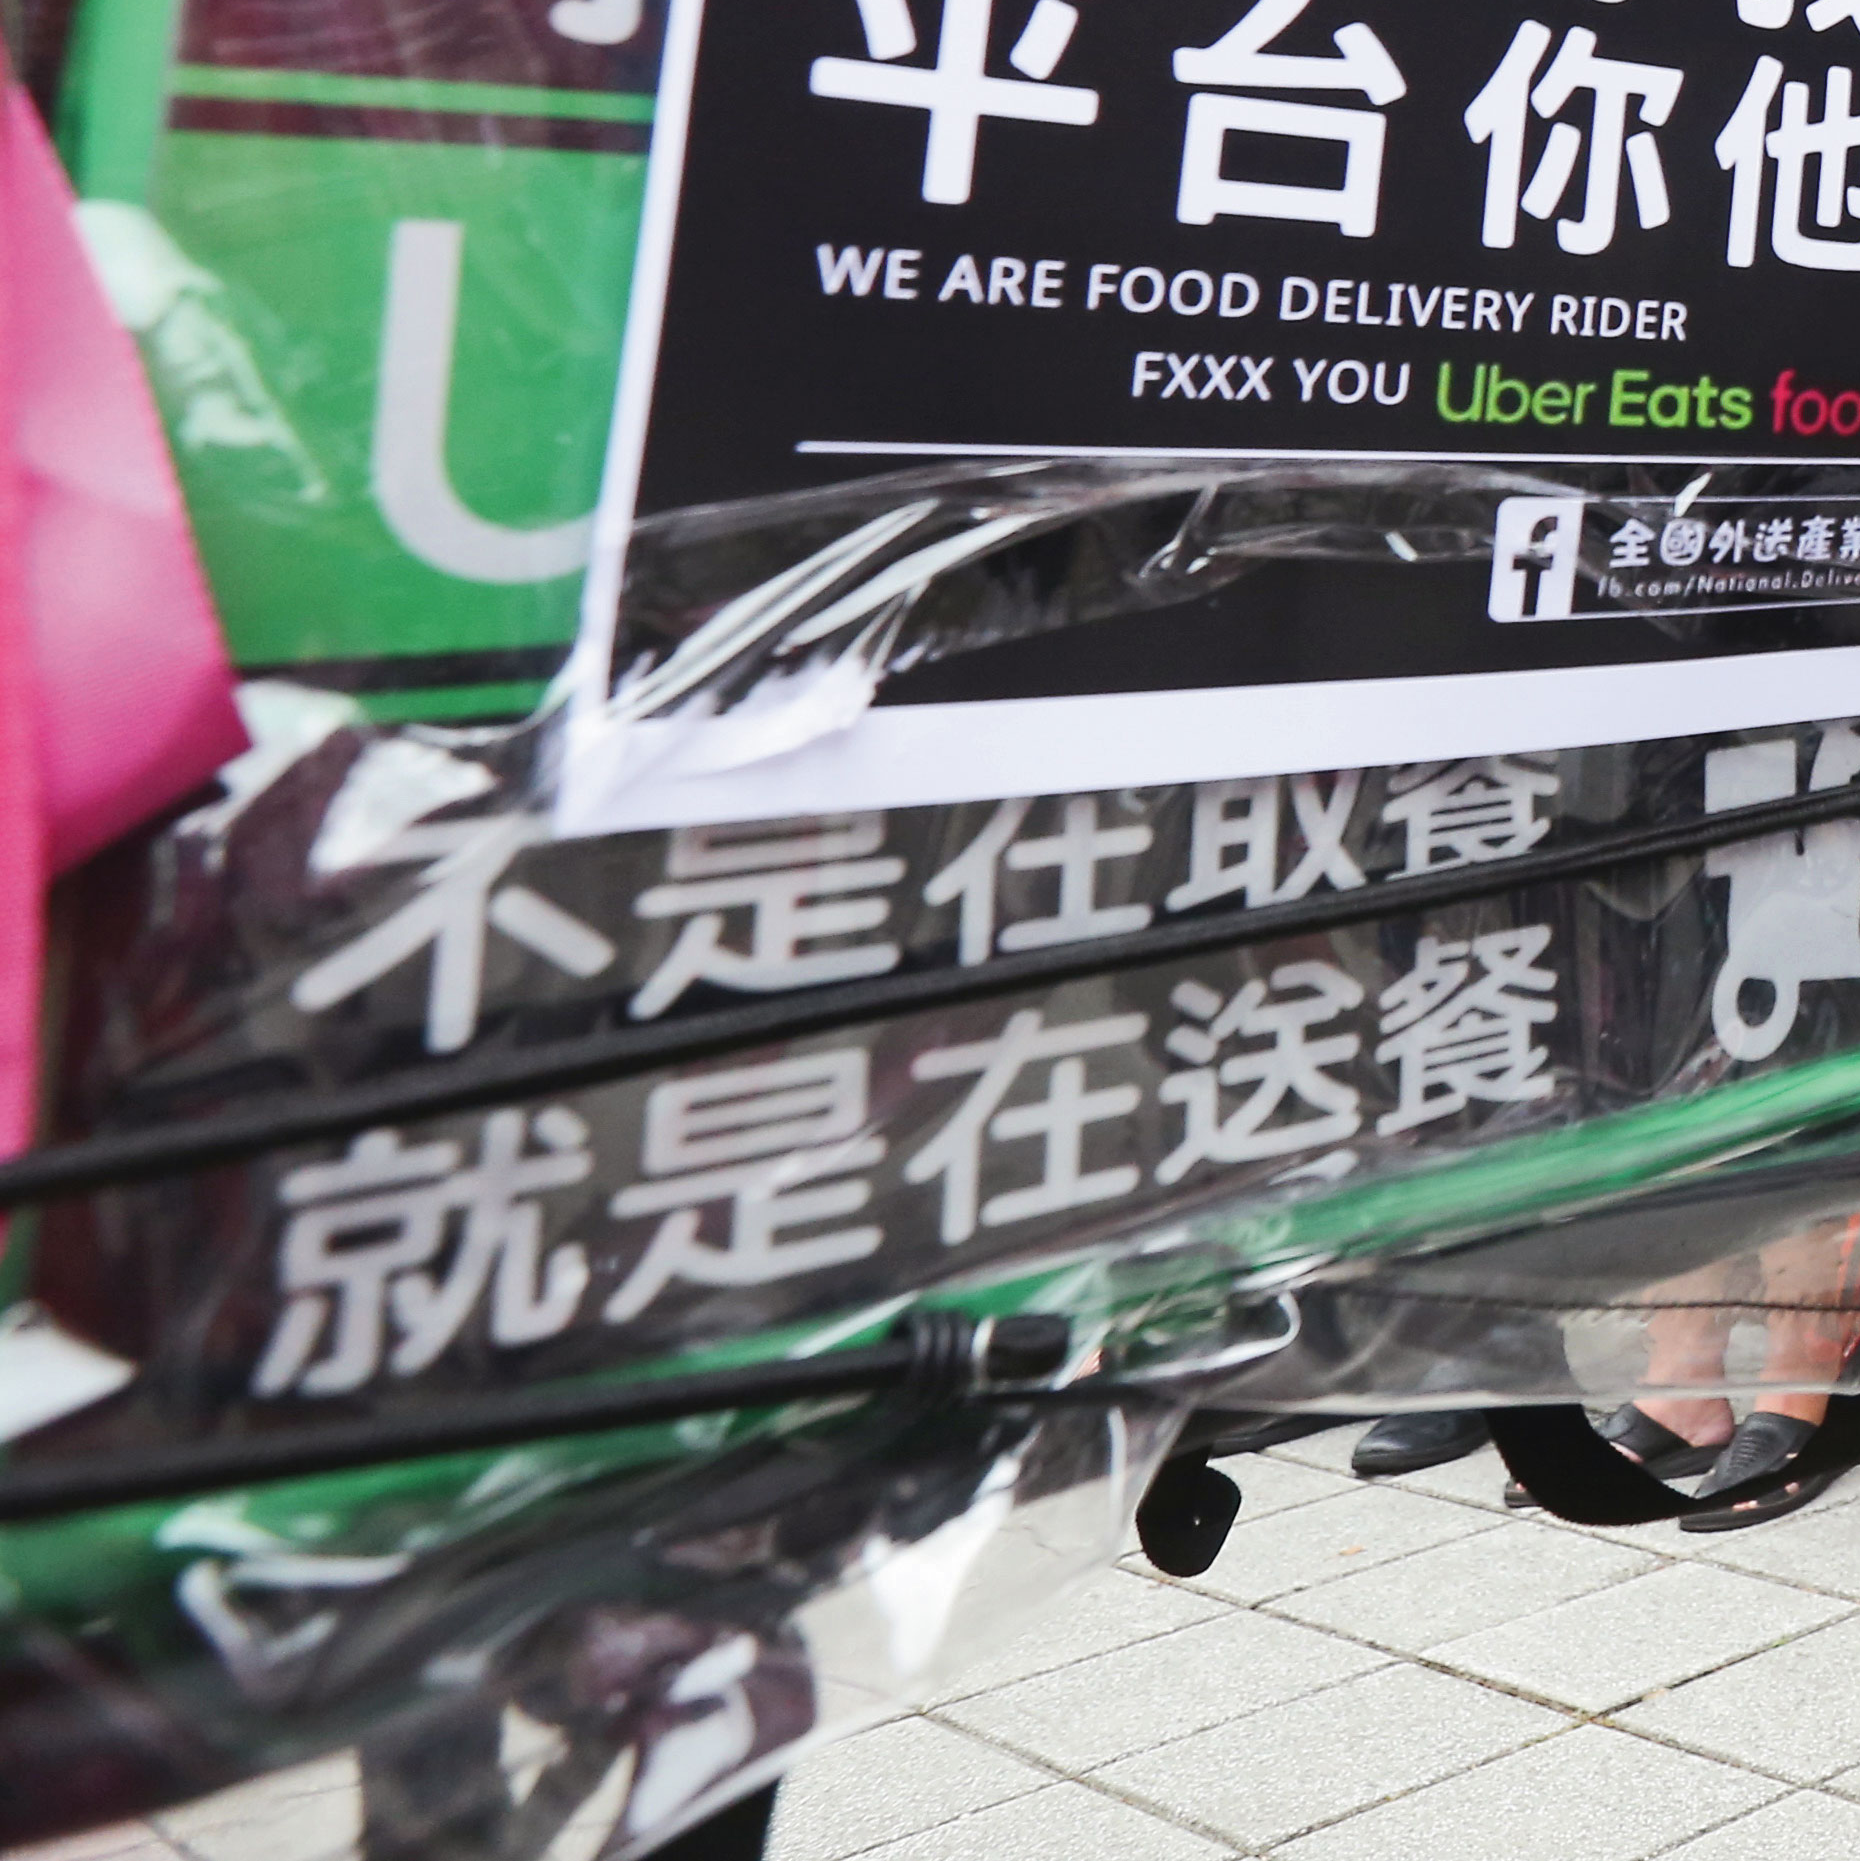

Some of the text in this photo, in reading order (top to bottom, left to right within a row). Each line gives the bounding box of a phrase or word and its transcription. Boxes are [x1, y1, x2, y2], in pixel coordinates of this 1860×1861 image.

[815, 243, 1691, 343] WE ARE FOOD DELIVERY RIDER
[1131, 350, 1275, 402] FXXX
[1293, 357, 1412, 407] YOU
[1435, 360, 1597, 426] Uber
[1608, 369, 1754, 431] Eats
[254, 924, 1562, 1398] 就是在送餐
